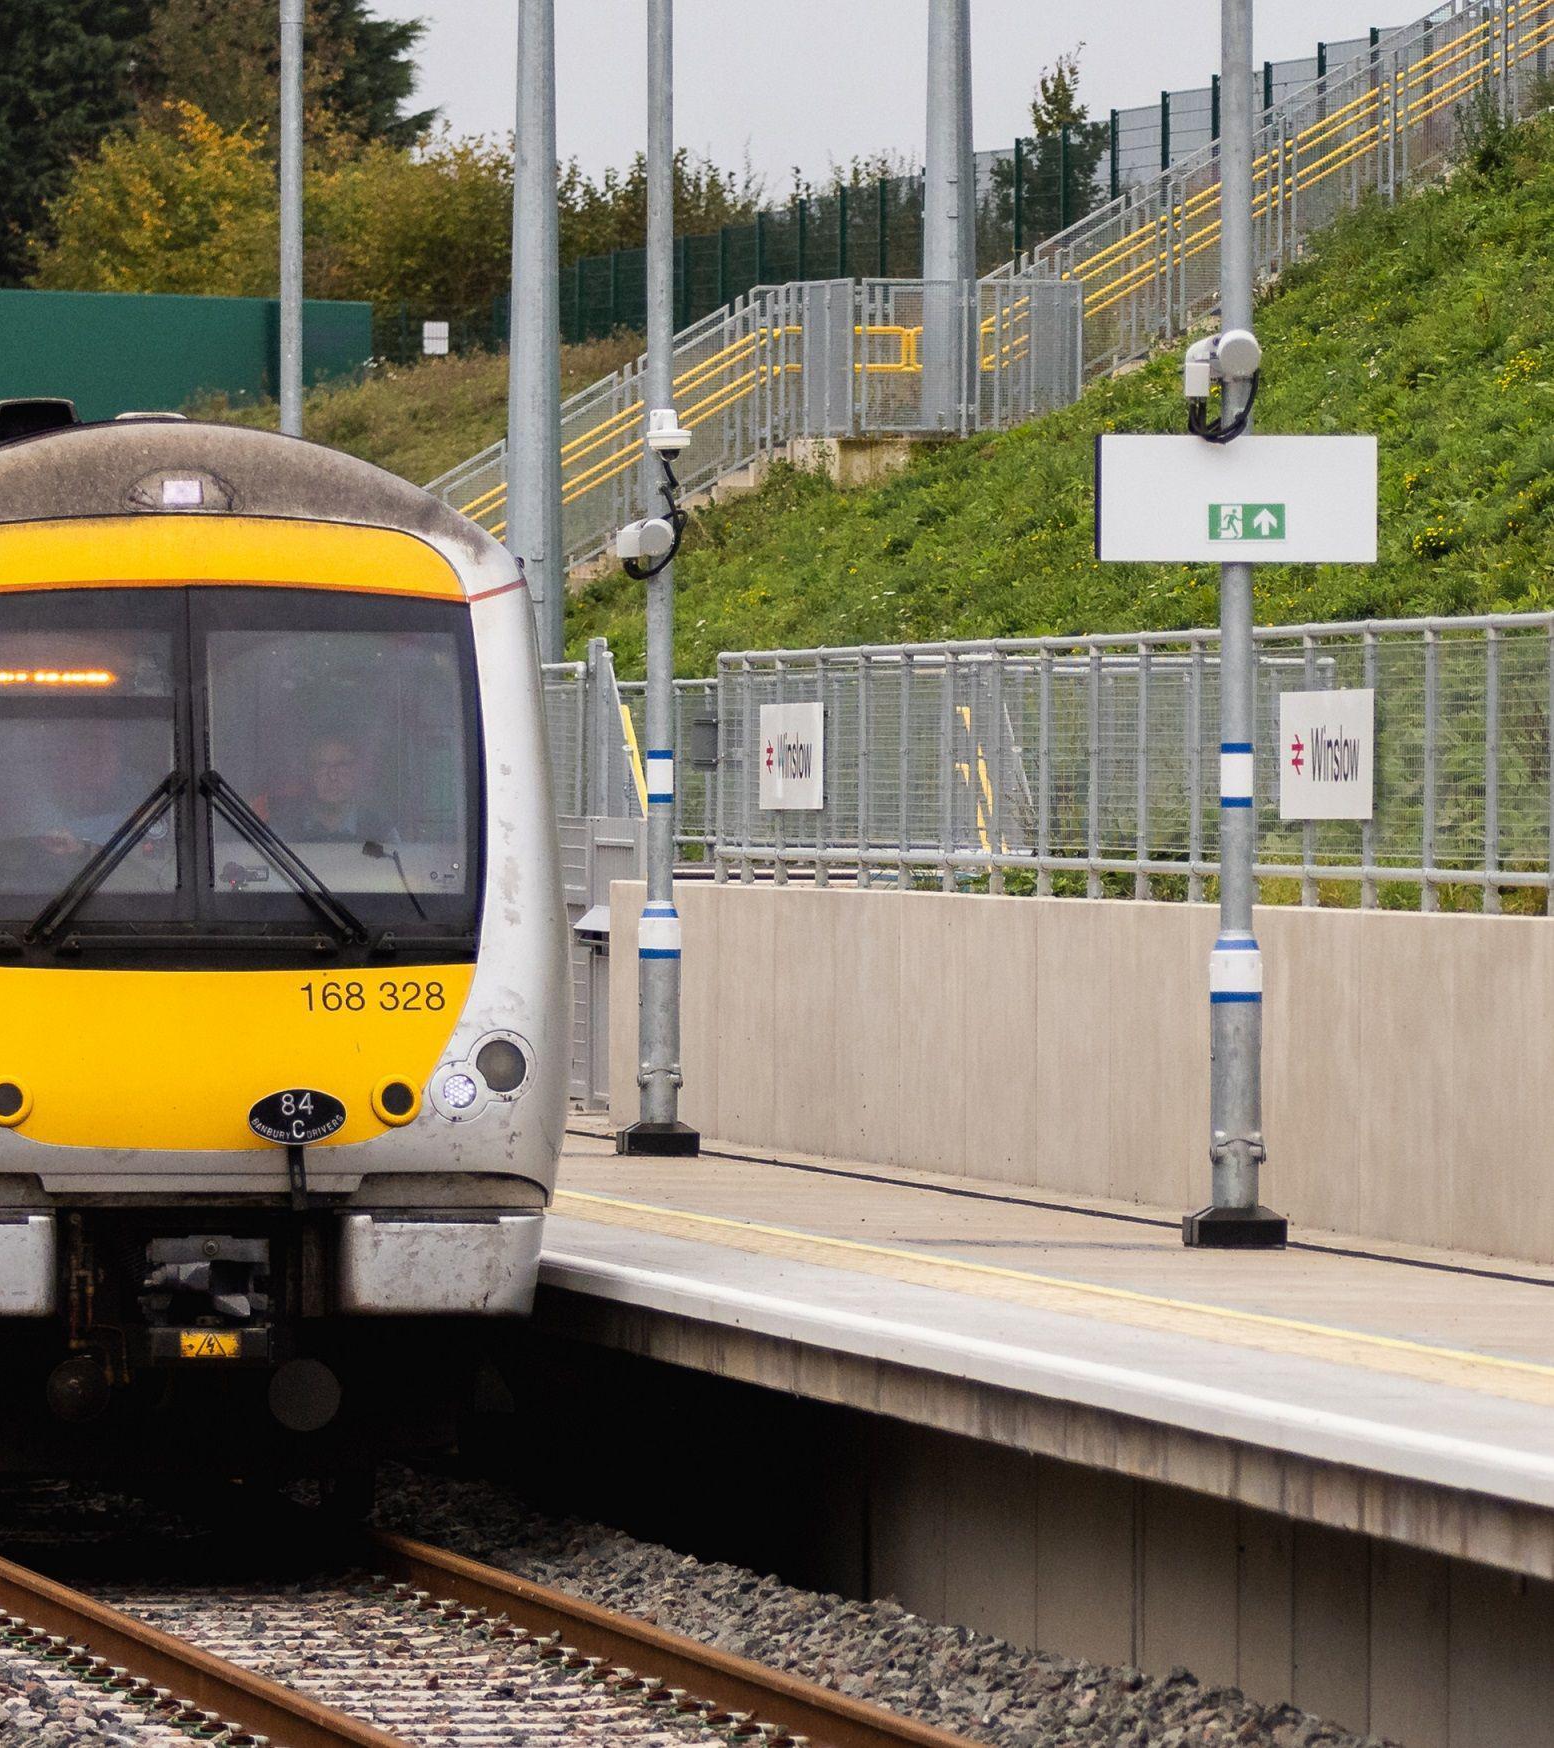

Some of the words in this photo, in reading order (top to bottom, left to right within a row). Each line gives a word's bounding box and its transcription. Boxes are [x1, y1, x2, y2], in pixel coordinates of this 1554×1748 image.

[777, 731, 813, 779] Winslow
[1311, 724, 1360, 782] Winslow
[300, 981, 366, 1011] 168
[379, 981, 446, 1011] 328
[281, 1092, 314, 1116] 84
[251, 1117, 291, 1140] BANBURY
[306, 1114, 344, 1140] DRIVERS
[292, 1119, 306, 1139] C
